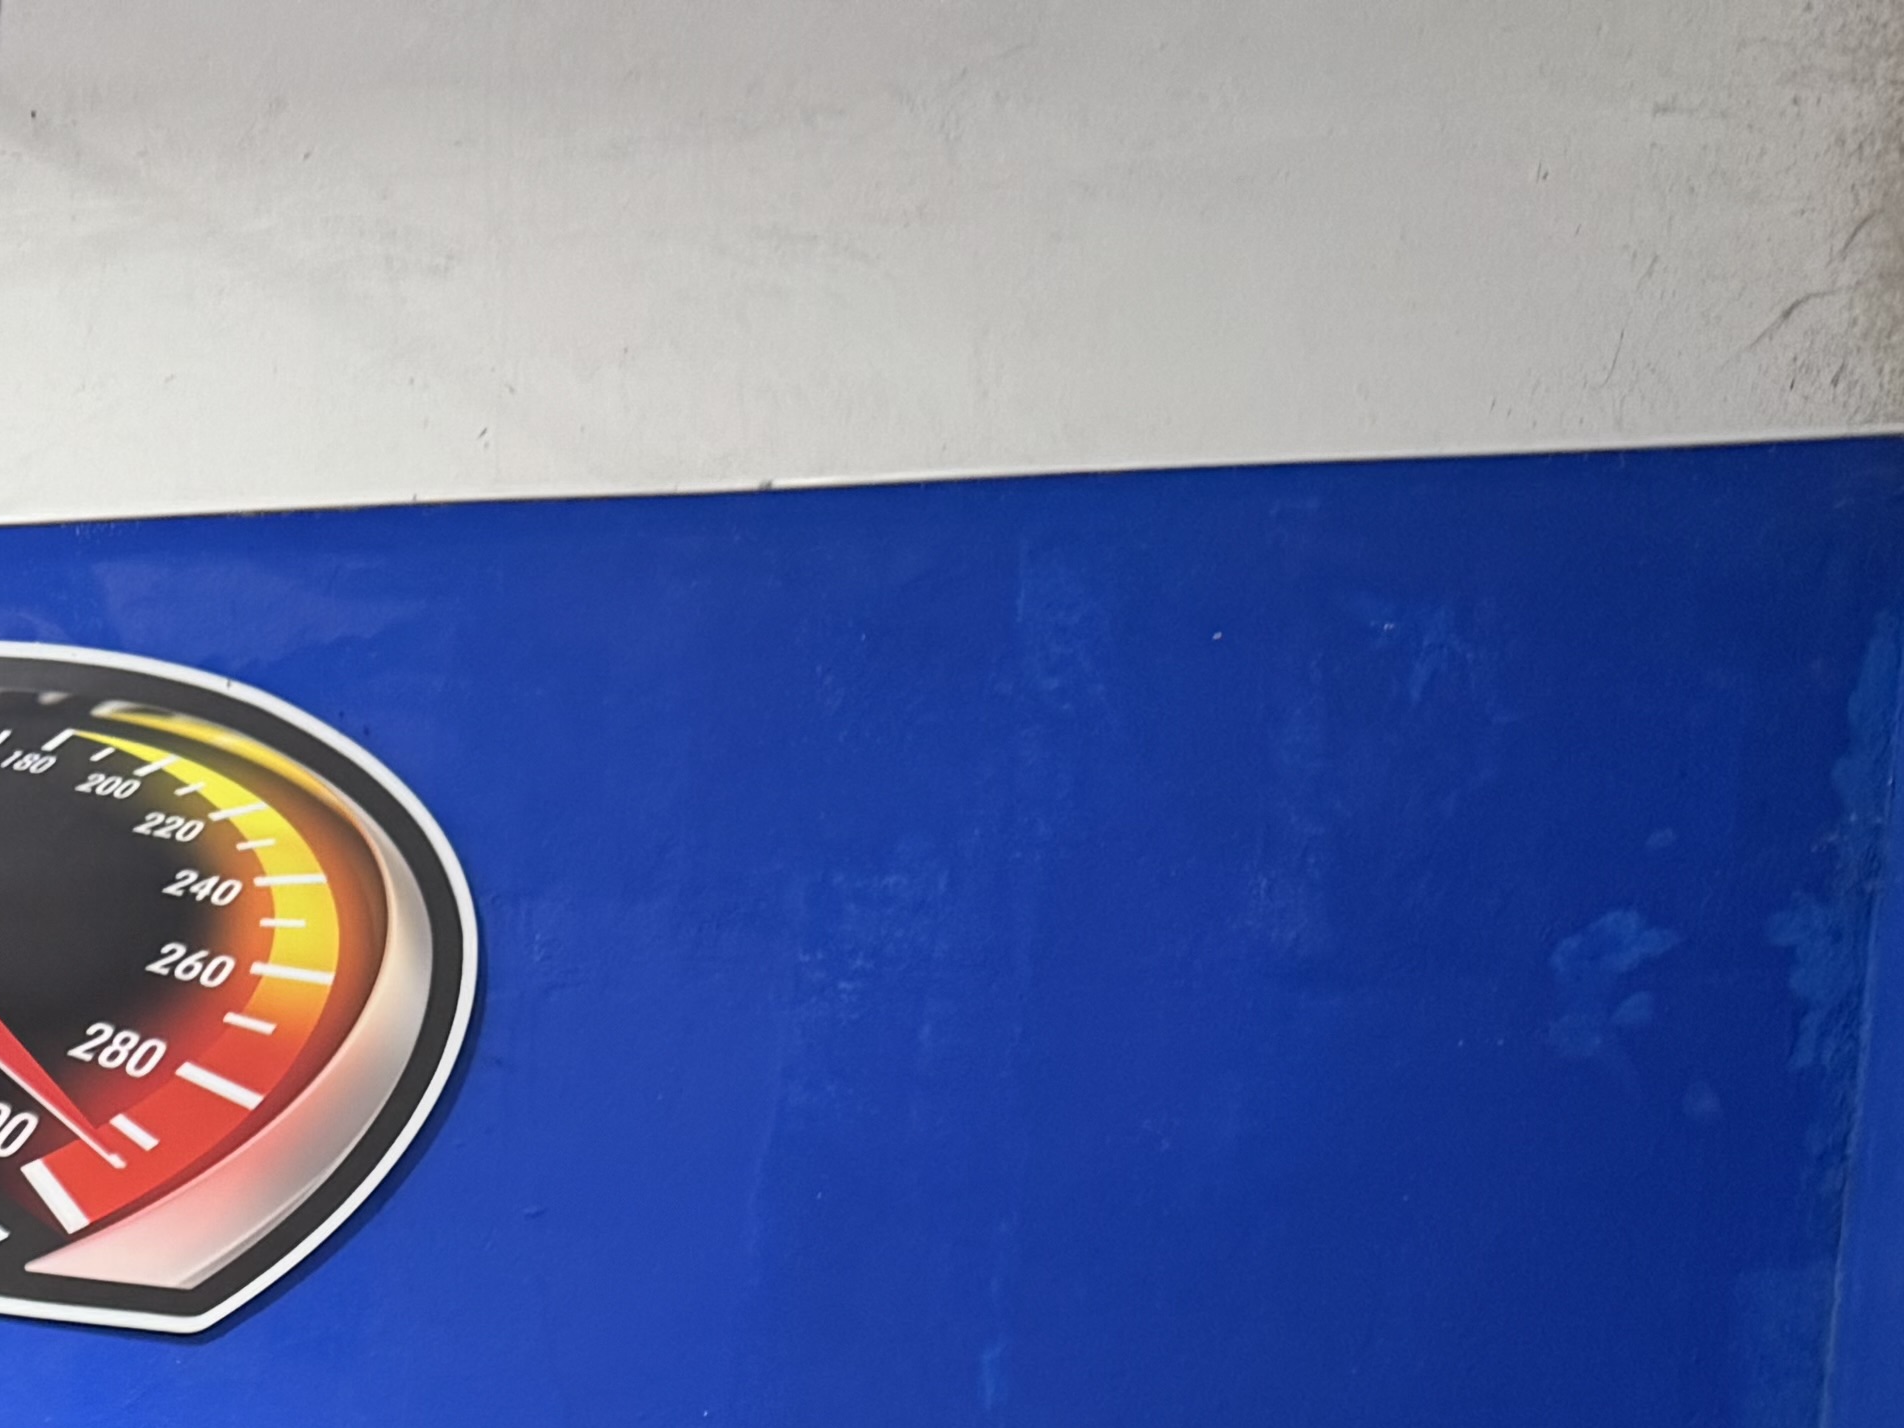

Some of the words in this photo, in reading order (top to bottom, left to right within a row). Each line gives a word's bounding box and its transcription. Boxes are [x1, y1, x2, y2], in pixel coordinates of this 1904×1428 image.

[0, 750, 57, 774] 180
[74, 773, 142, 799] 200
[133, 812, 205, 842] 220
[162, 869, 243, 906] 240
[145, 942, 235, 988] 260
[67, 1022, 167, 1078] 280
